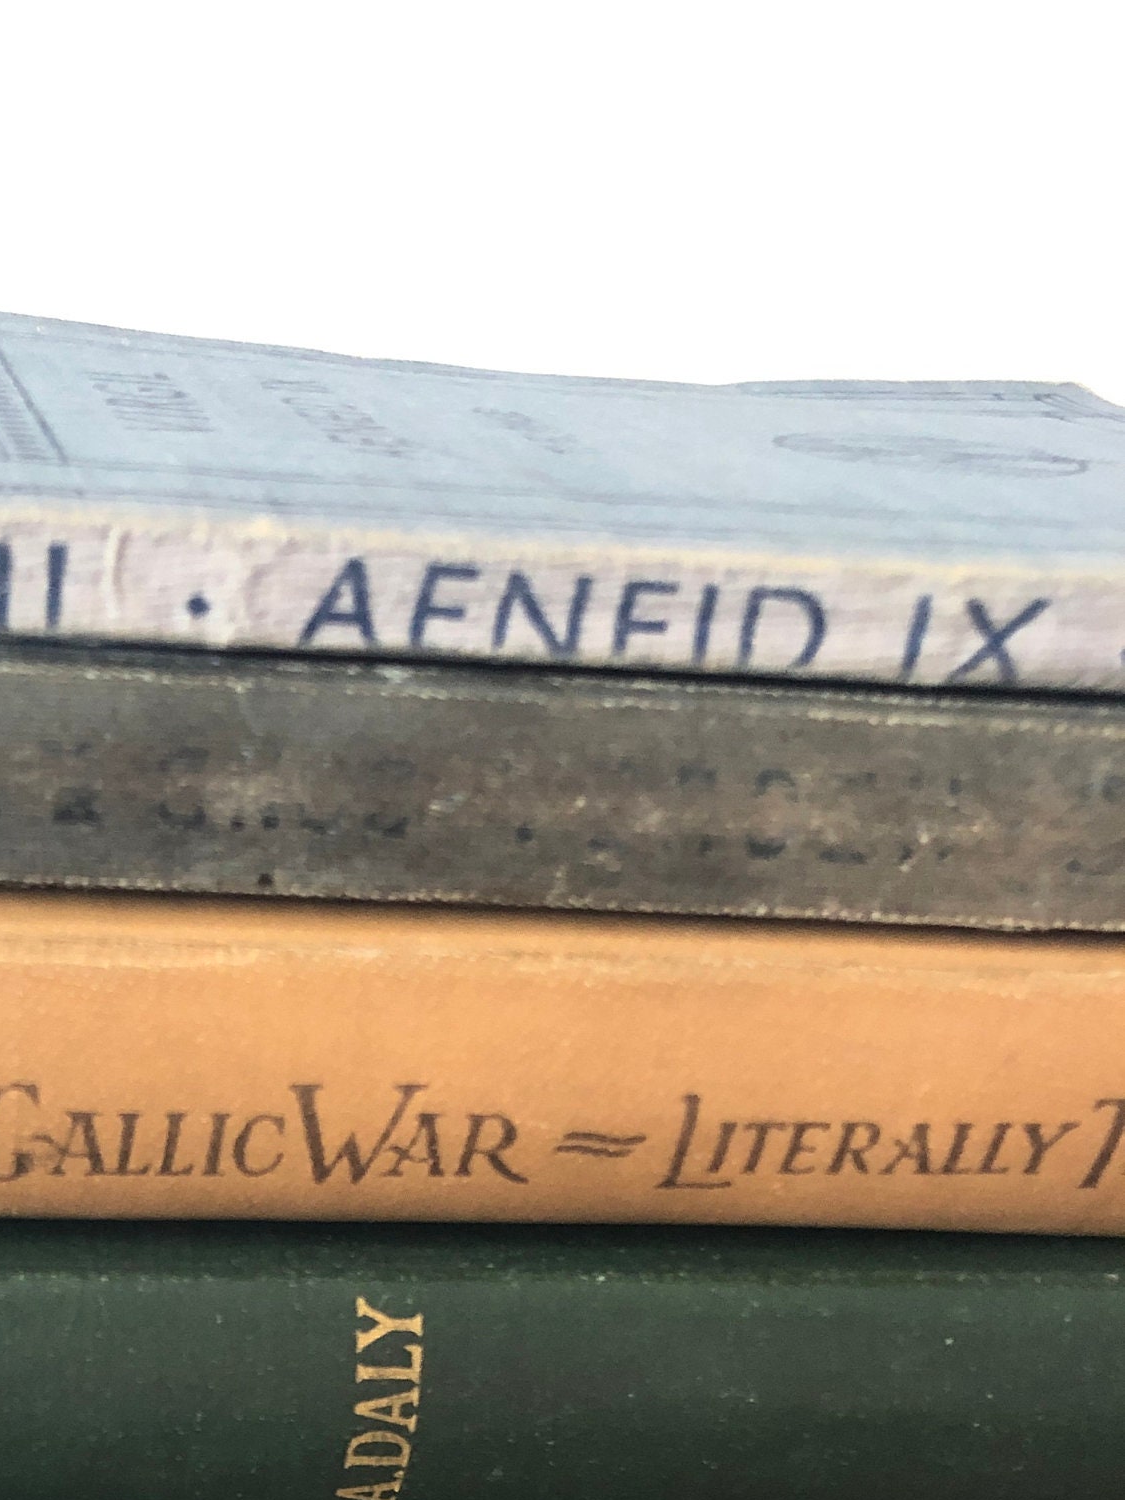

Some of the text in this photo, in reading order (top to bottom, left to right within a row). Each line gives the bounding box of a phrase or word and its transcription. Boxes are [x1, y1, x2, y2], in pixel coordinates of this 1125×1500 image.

[897, 593, 1053, 686] IX
[288, 1083, 530, 1186] WAR
[656, 1093, 1081, 1190] LITERALLY
